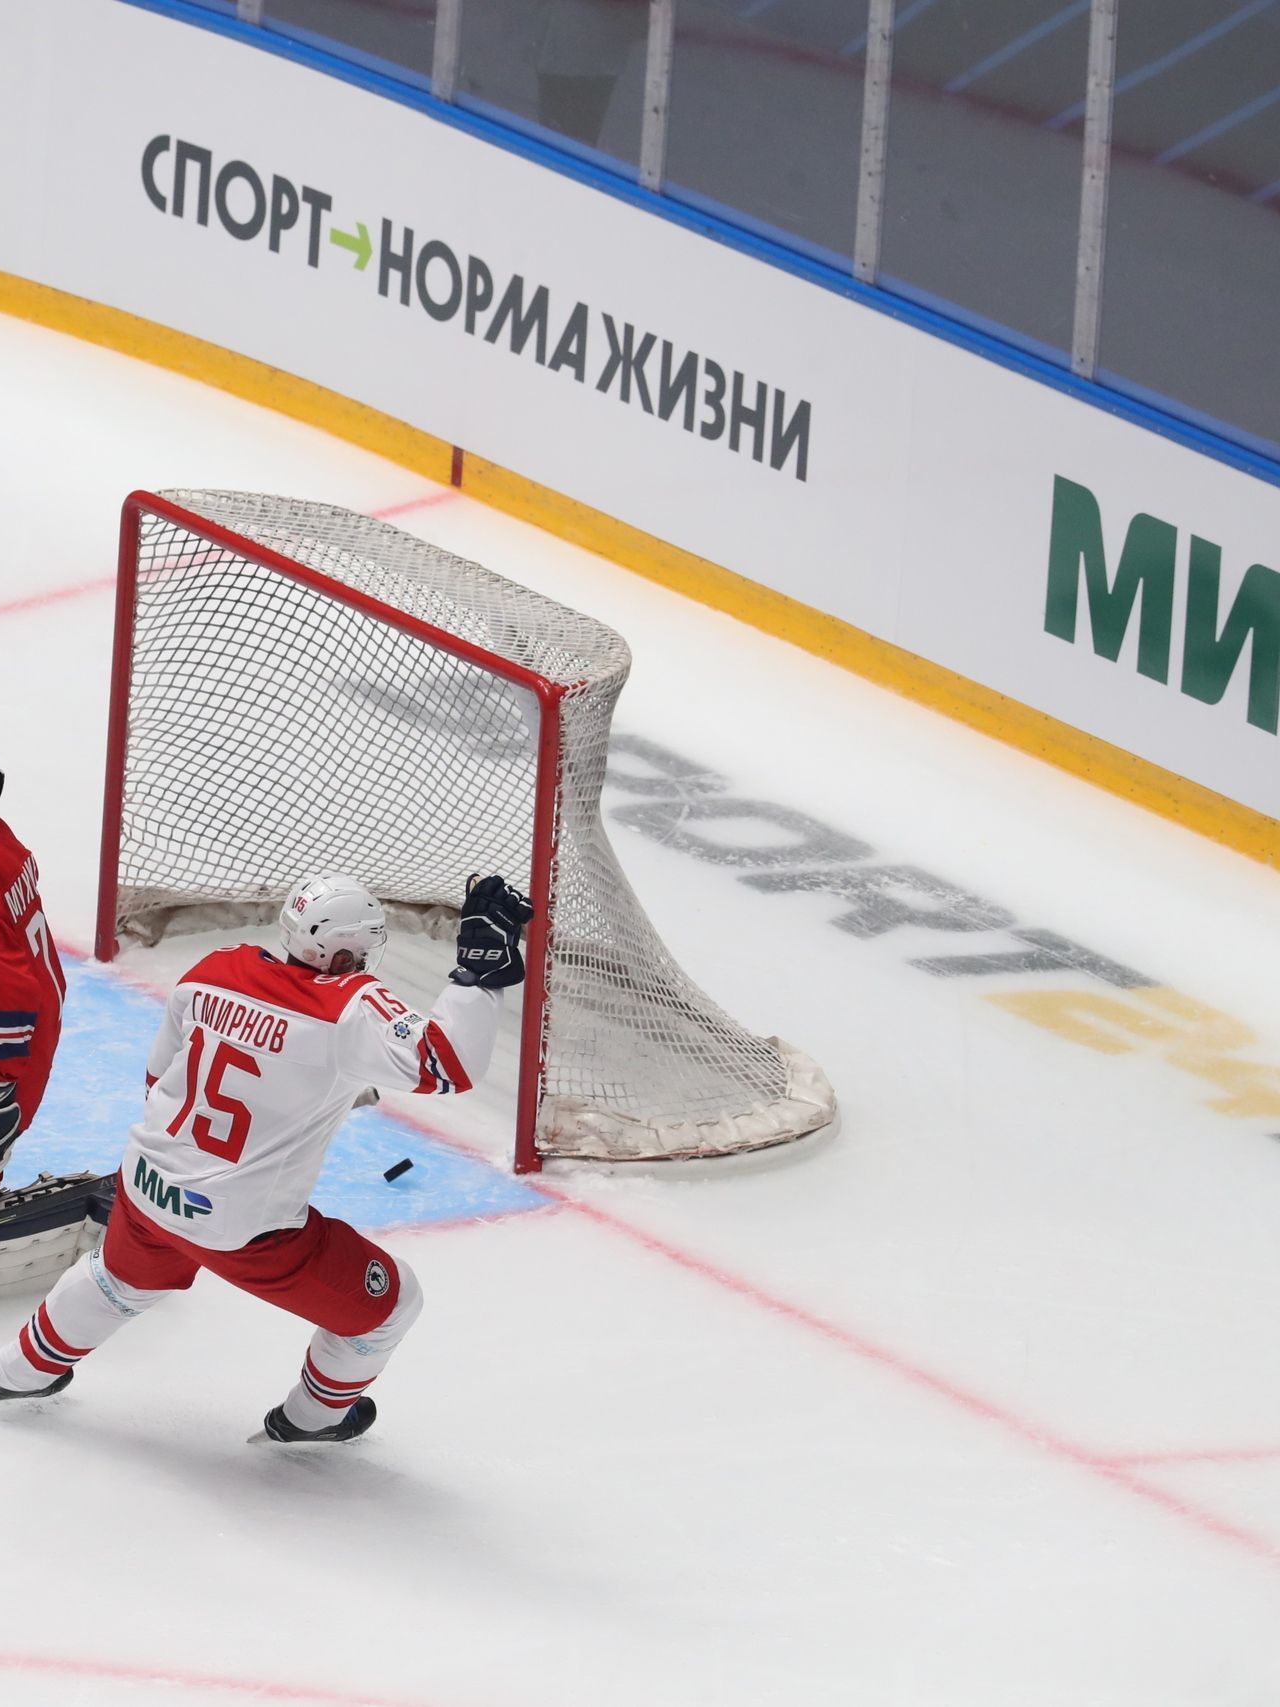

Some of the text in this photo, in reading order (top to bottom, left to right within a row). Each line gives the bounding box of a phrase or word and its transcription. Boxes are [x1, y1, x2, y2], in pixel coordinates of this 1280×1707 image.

[141, 134, 332, 268] СПОРТ
[295, 896, 308, 912] 15
[192, 990, 288, 1053] СМИРНОВ
[361, 988, 408, 1022] 15
[166, 1026, 261, 1164] 15
[134, 1155, 213, 1219] МИР
